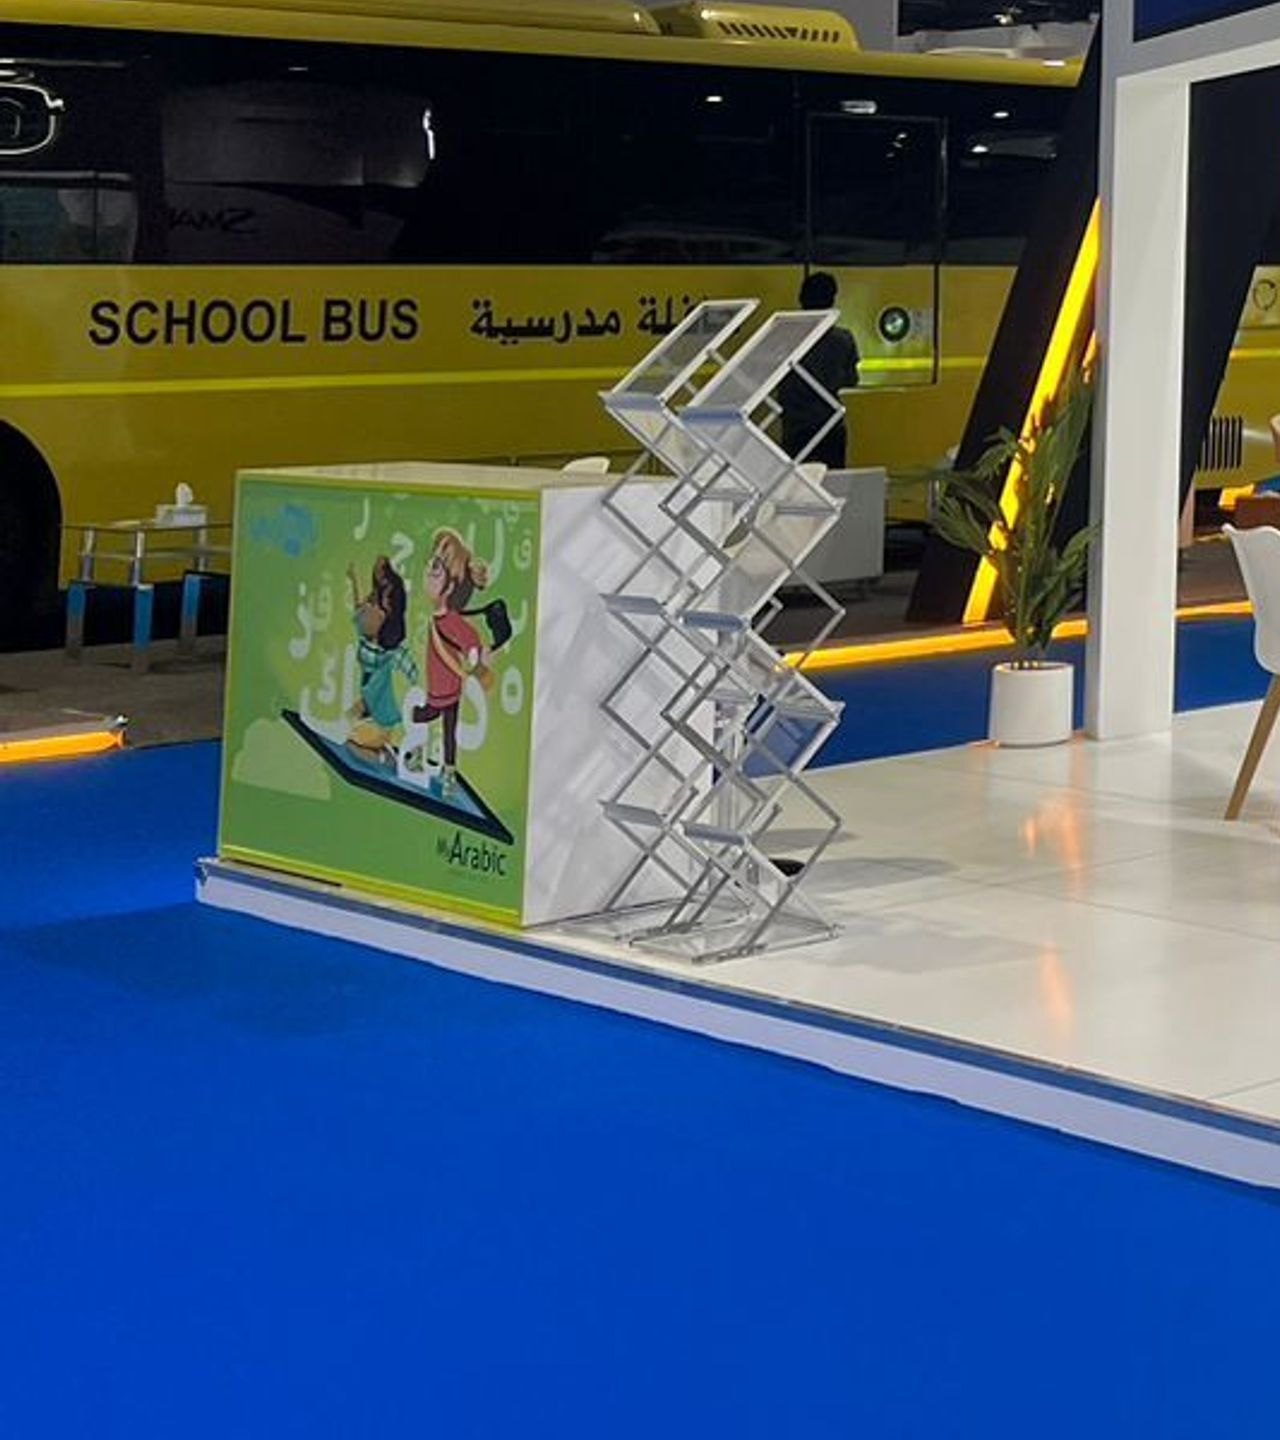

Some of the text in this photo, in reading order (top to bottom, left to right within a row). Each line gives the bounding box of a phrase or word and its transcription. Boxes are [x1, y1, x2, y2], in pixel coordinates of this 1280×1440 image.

[89, 298, 419, 345] SCHOOL BUS
[470, 299, 622, 345] مدرسية
